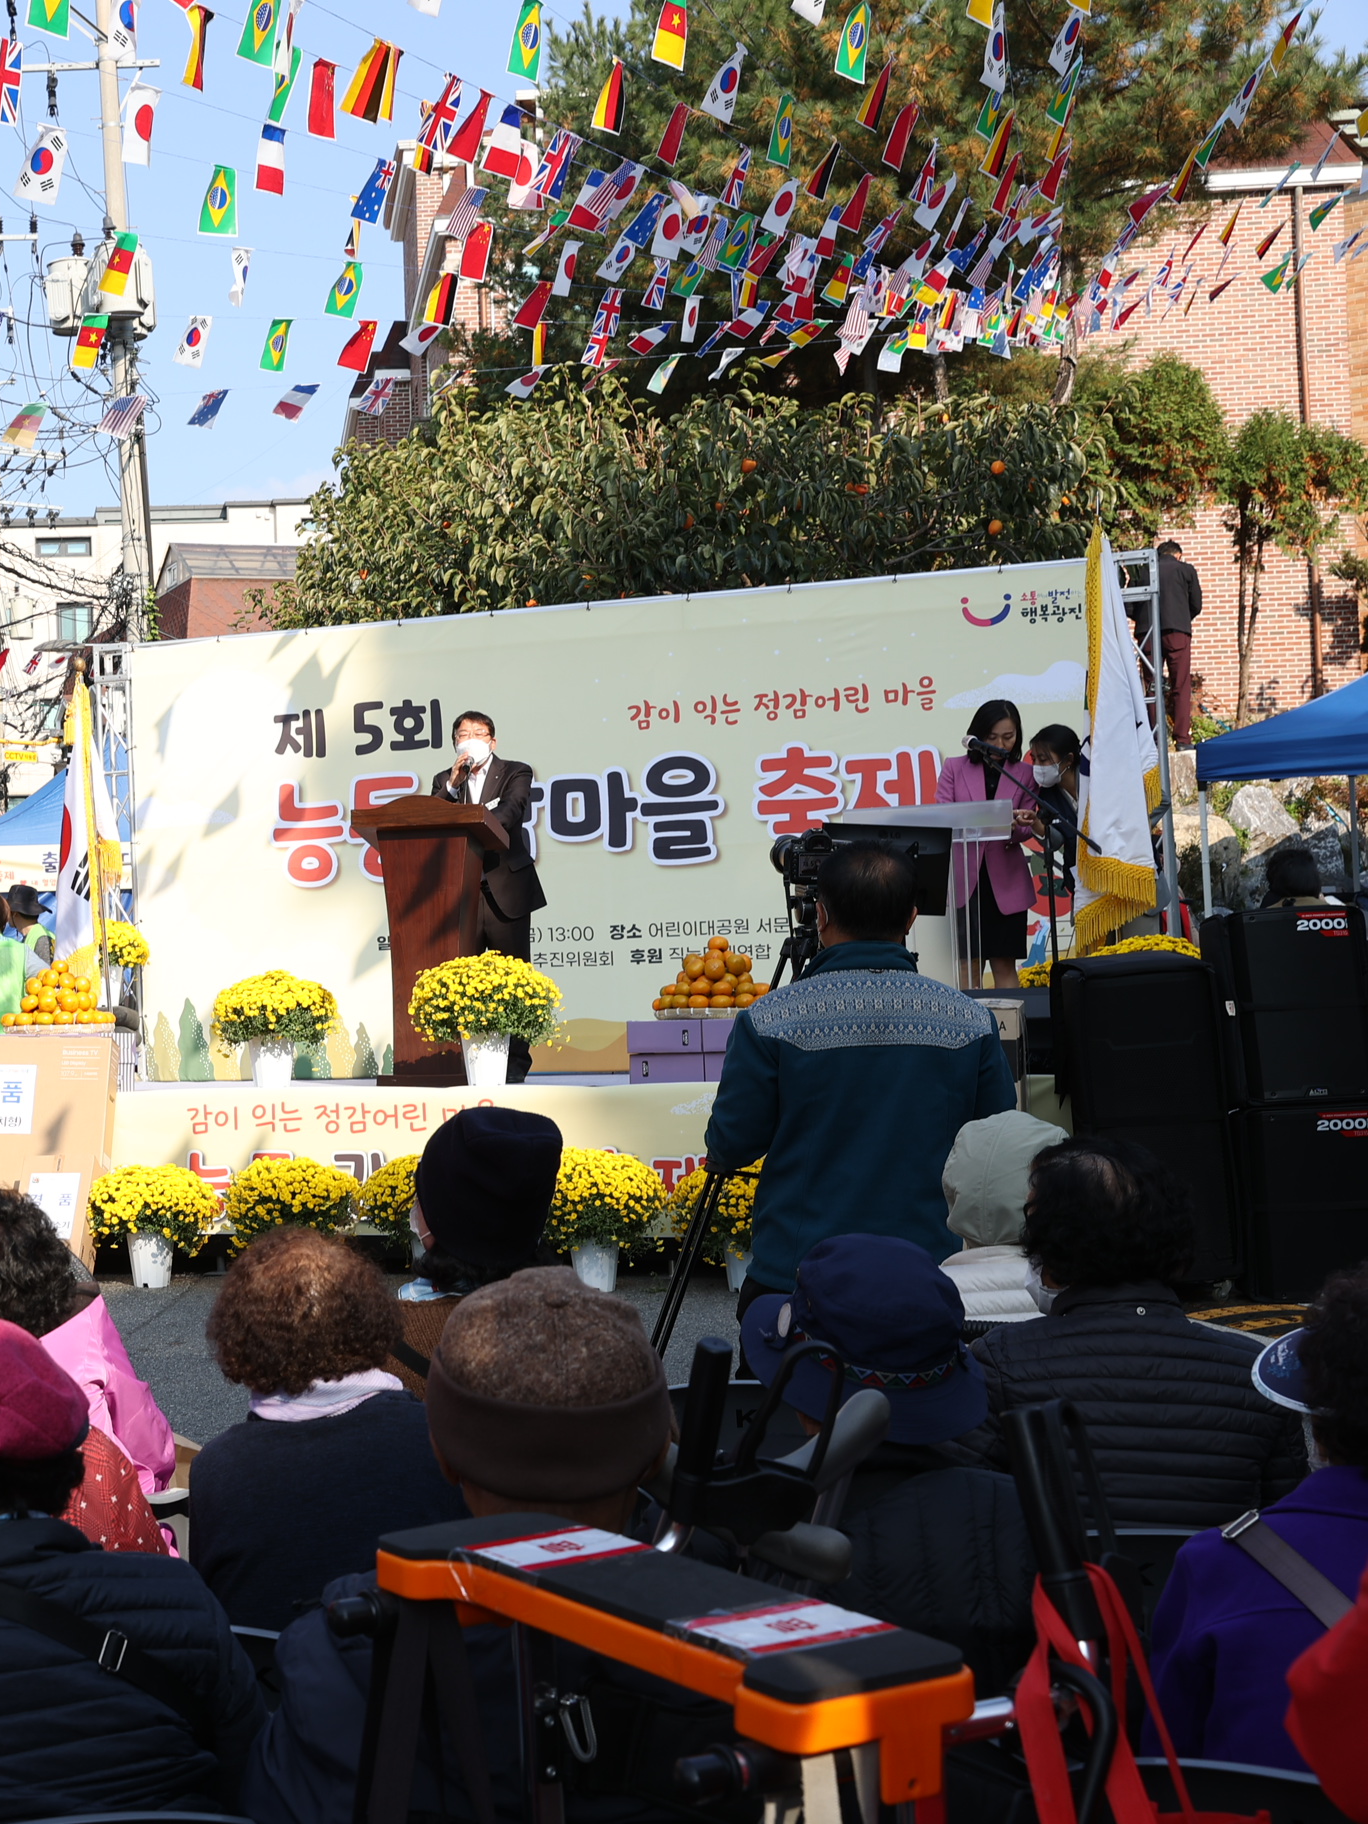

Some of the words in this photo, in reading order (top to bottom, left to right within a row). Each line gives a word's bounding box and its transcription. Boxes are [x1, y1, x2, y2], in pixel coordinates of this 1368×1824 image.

[1021, 603, 1082, 624] 행복광진
[628, 698, 680, 731] 감이
[693, 692, 741, 726] 익는
[753, 682, 870, 722] 정감어린
[884, 675, 937, 712] 마을
[273, 708, 327, 758] 제
[353, 698, 443, 756] 5회
[5, 751, 23, 760] CCTV
[548, 926, 595, 943] 13:00
[609, 923, 643, 940] 장소
[648, 918, 750, 938] 어린이대공원
[630, 948, 663, 965] 후원
[187, 1103, 238, 1135] 감이
[251, 1101, 303, 1133] 익는
[314, 1101, 428, 1134] 정감어린
